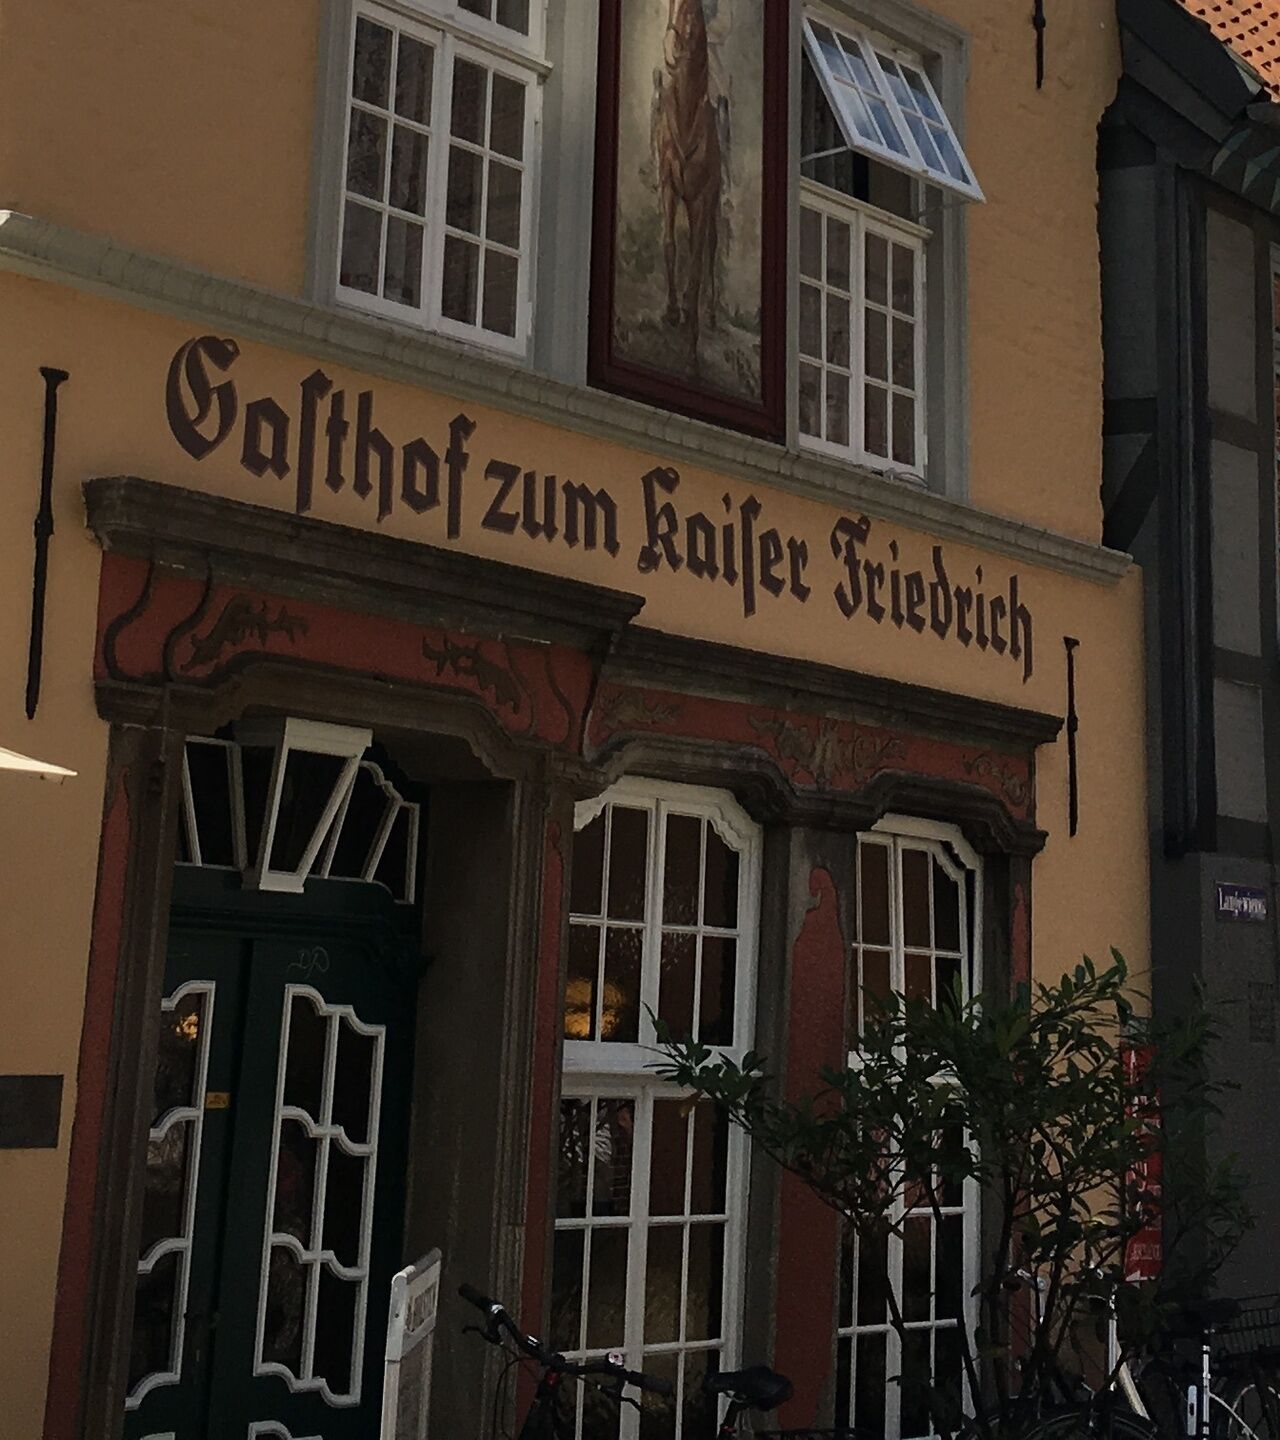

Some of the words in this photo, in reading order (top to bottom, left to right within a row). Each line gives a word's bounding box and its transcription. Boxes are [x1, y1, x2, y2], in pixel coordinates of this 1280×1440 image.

[165, 335, 477, 539] Gasthof
[484, 458, 619, 557] zum
[829, 516, 1034, 685] Friedrich
